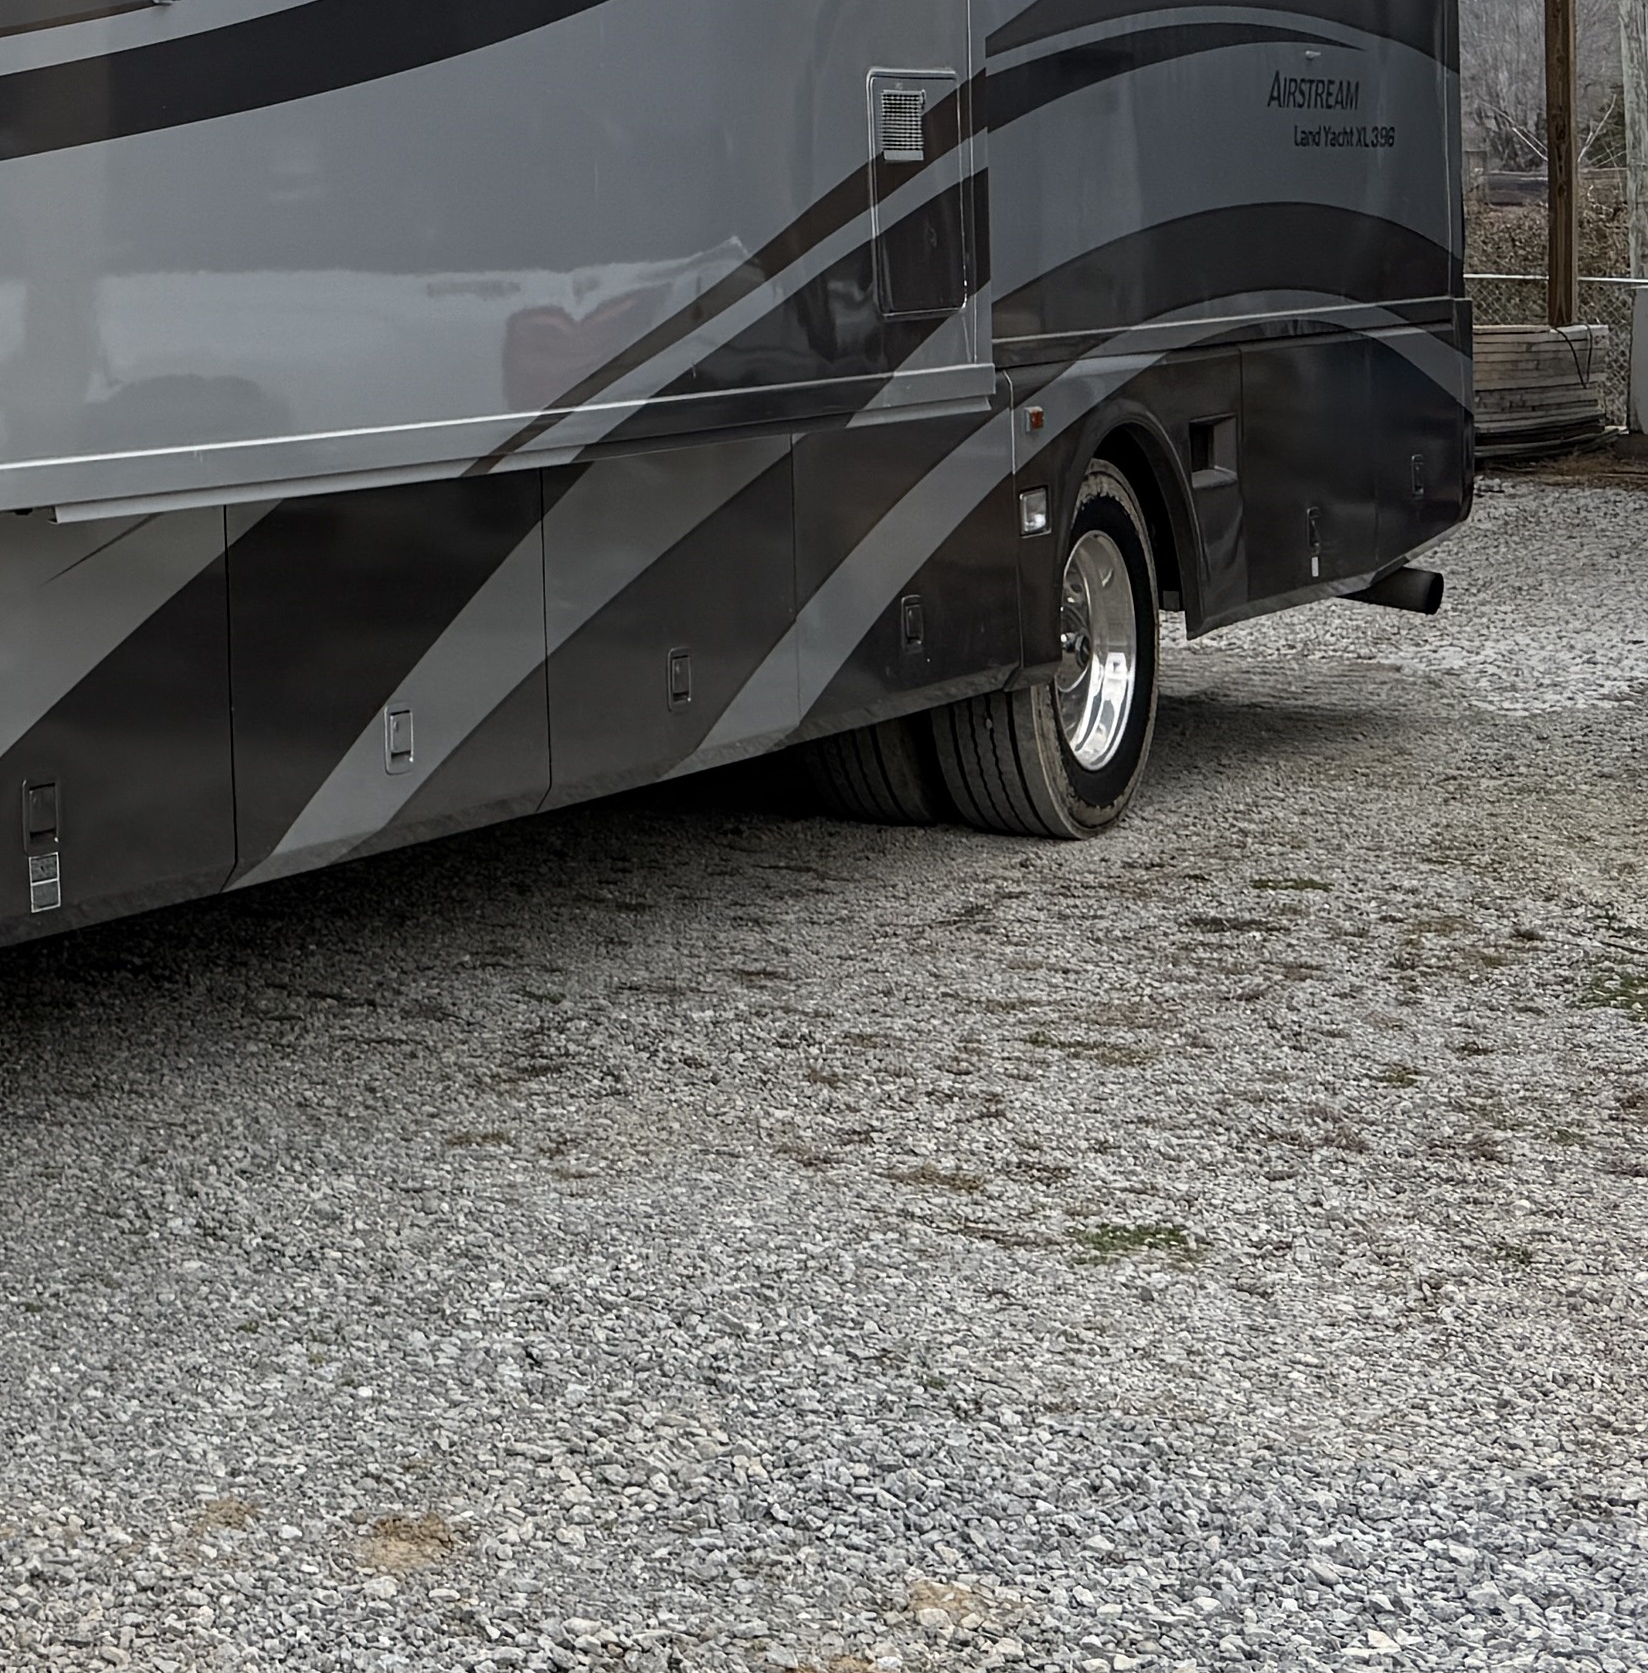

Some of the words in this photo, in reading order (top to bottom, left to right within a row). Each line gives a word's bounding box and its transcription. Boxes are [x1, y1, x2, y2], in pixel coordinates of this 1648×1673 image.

[1267, 70, 1360, 110] AIRSTREAM
[1294, 125, 1321, 147] Land
[1323, 125, 1354, 148] Yacht
[1355, 127, 1370, 148] XL
